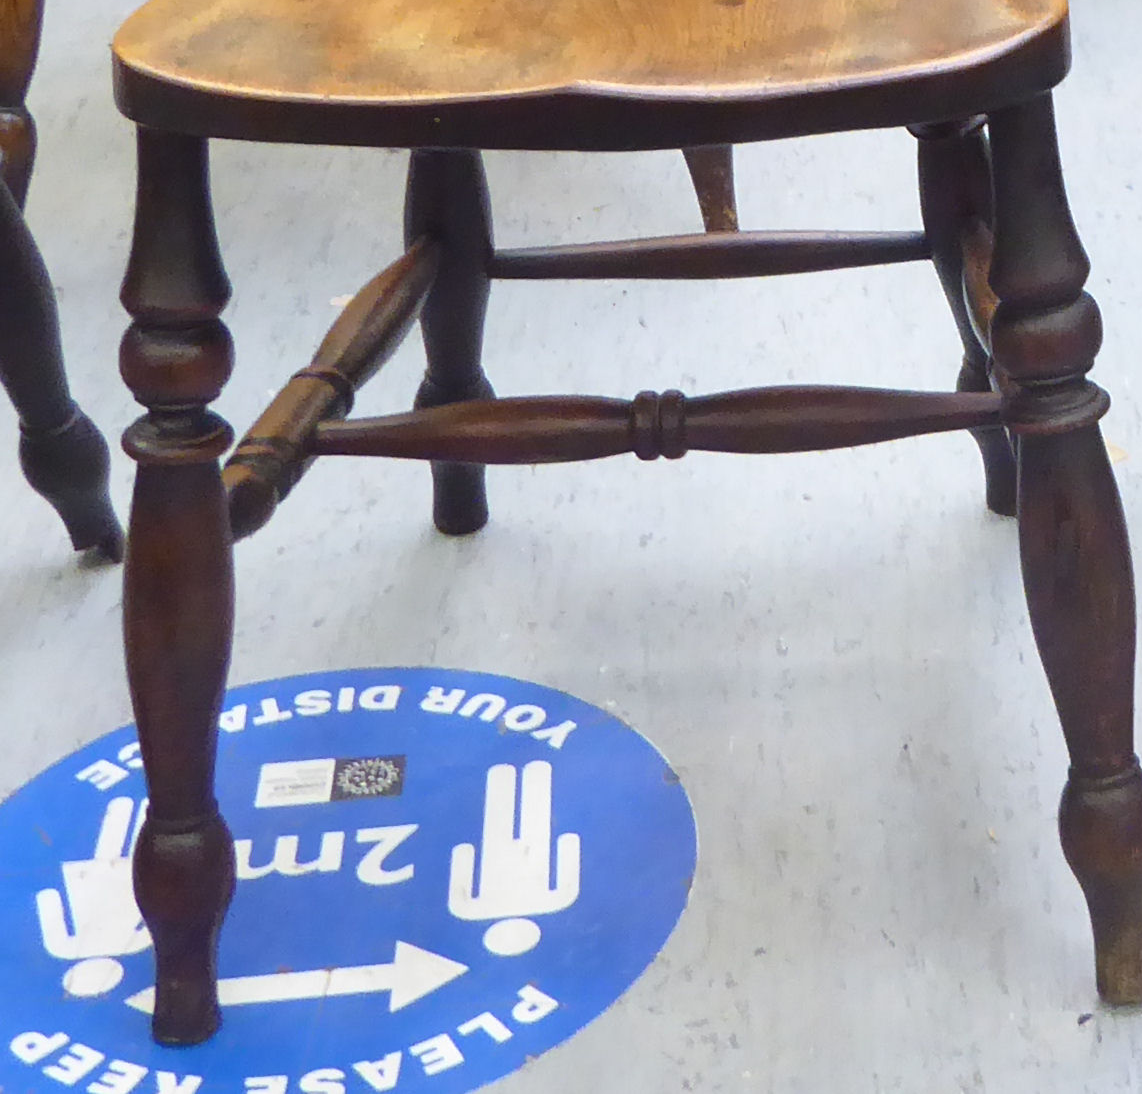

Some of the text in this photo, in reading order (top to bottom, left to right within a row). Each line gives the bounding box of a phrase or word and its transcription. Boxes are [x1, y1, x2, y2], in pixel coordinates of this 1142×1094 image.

[75, 685, 402, 790] DISTACE
[420, 685, 577, 749] YOUR
[234, 823, 419, 886] 2m
[9, 984, 559, 1094] PLEASE KEEP
